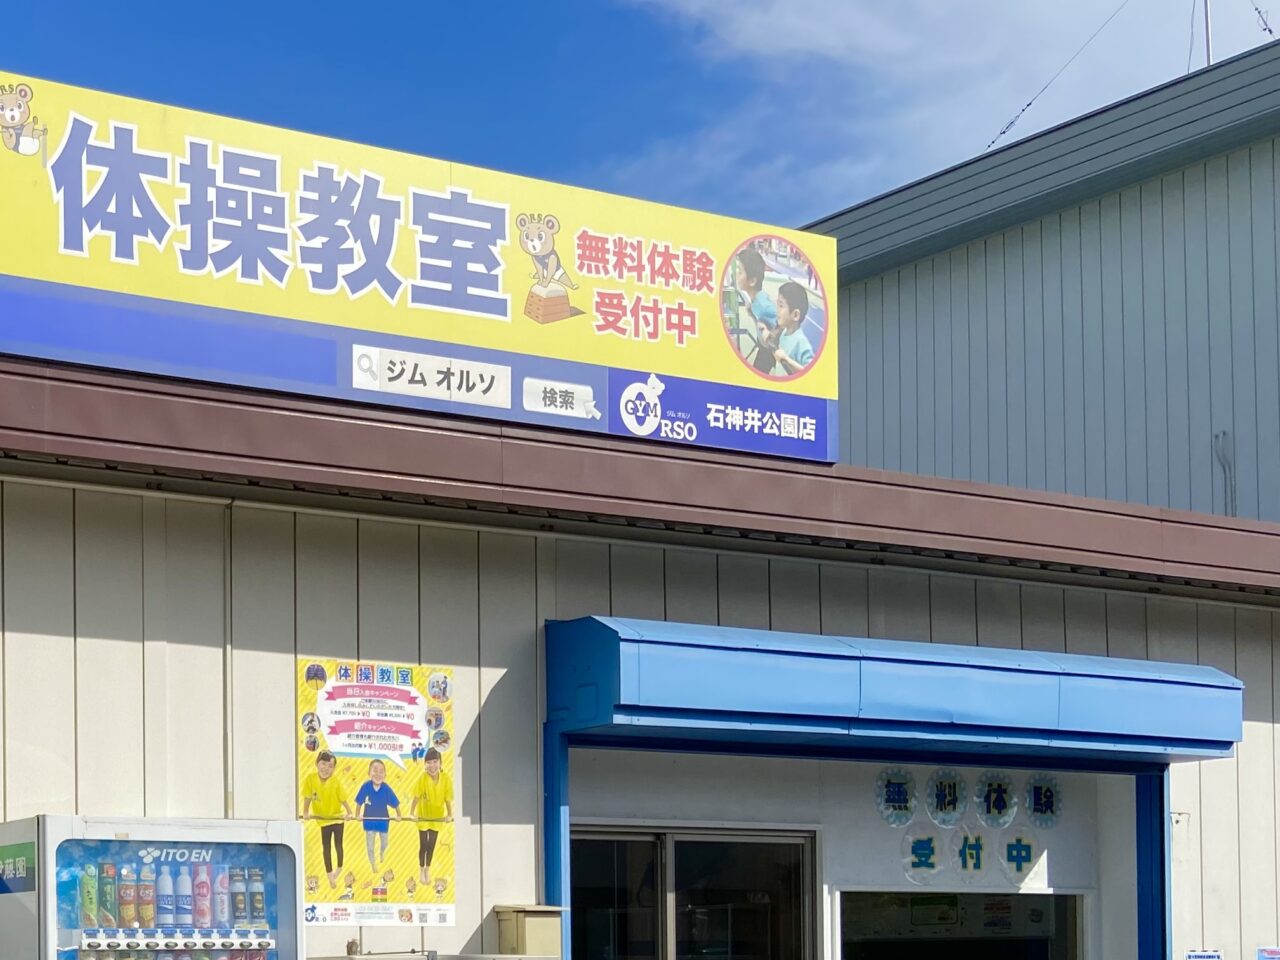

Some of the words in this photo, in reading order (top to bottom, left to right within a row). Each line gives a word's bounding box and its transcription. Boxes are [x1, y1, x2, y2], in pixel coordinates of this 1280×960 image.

[49, 115, 509, 319] 体操教室
[576, 229, 717, 294] 無料体験
[594, 290, 697, 346] 受付中
[387, 359, 427, 387] ジム
[436, 367, 496, 396] オルソ
[541, 386, 575, 411] 検索
[624, 399, 658, 418] GYM
[706, 402, 817, 442] 石神井公園店
[338, 665, 414, 685] 体操教室
[884, 780, 1055, 815] 無料体験
[160, 848, 189, 862] ITO
[190, 849, 213, 863] EN
[911, 836, 1032, 873] 受付中
